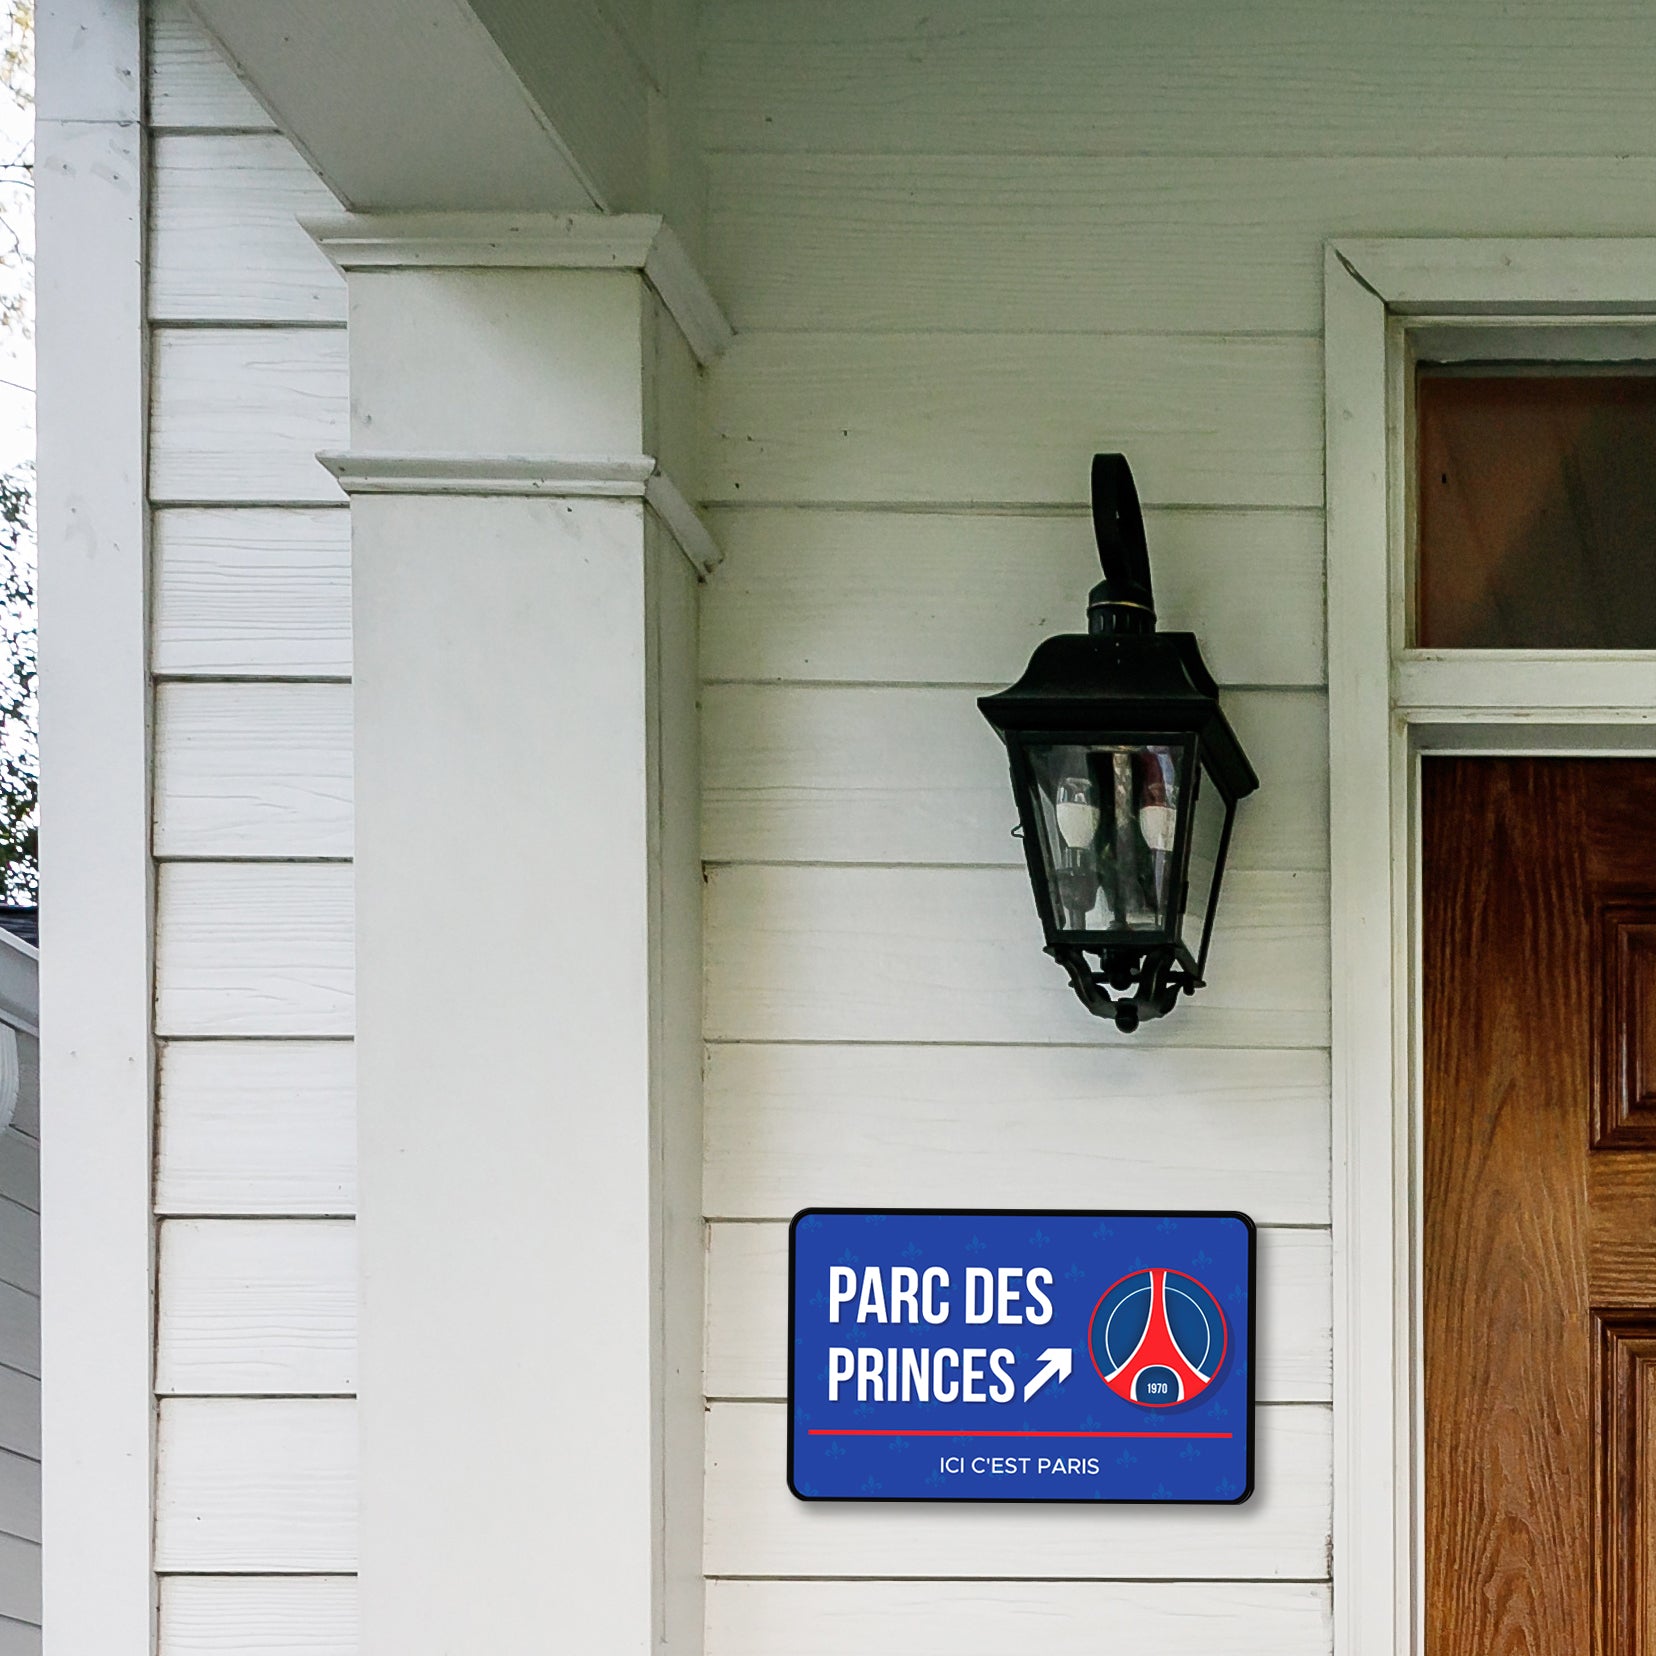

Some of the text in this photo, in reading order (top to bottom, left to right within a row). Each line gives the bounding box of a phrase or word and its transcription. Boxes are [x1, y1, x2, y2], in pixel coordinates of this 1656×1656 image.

[830, 1266, 1052, 1324] PARC DES
[829, 1348, 1015, 1402] PRINCES
[1147, 1382, 1168, 1394] 1970
[941, 1457, 1099, 1474] ICI C'EST PARIS
